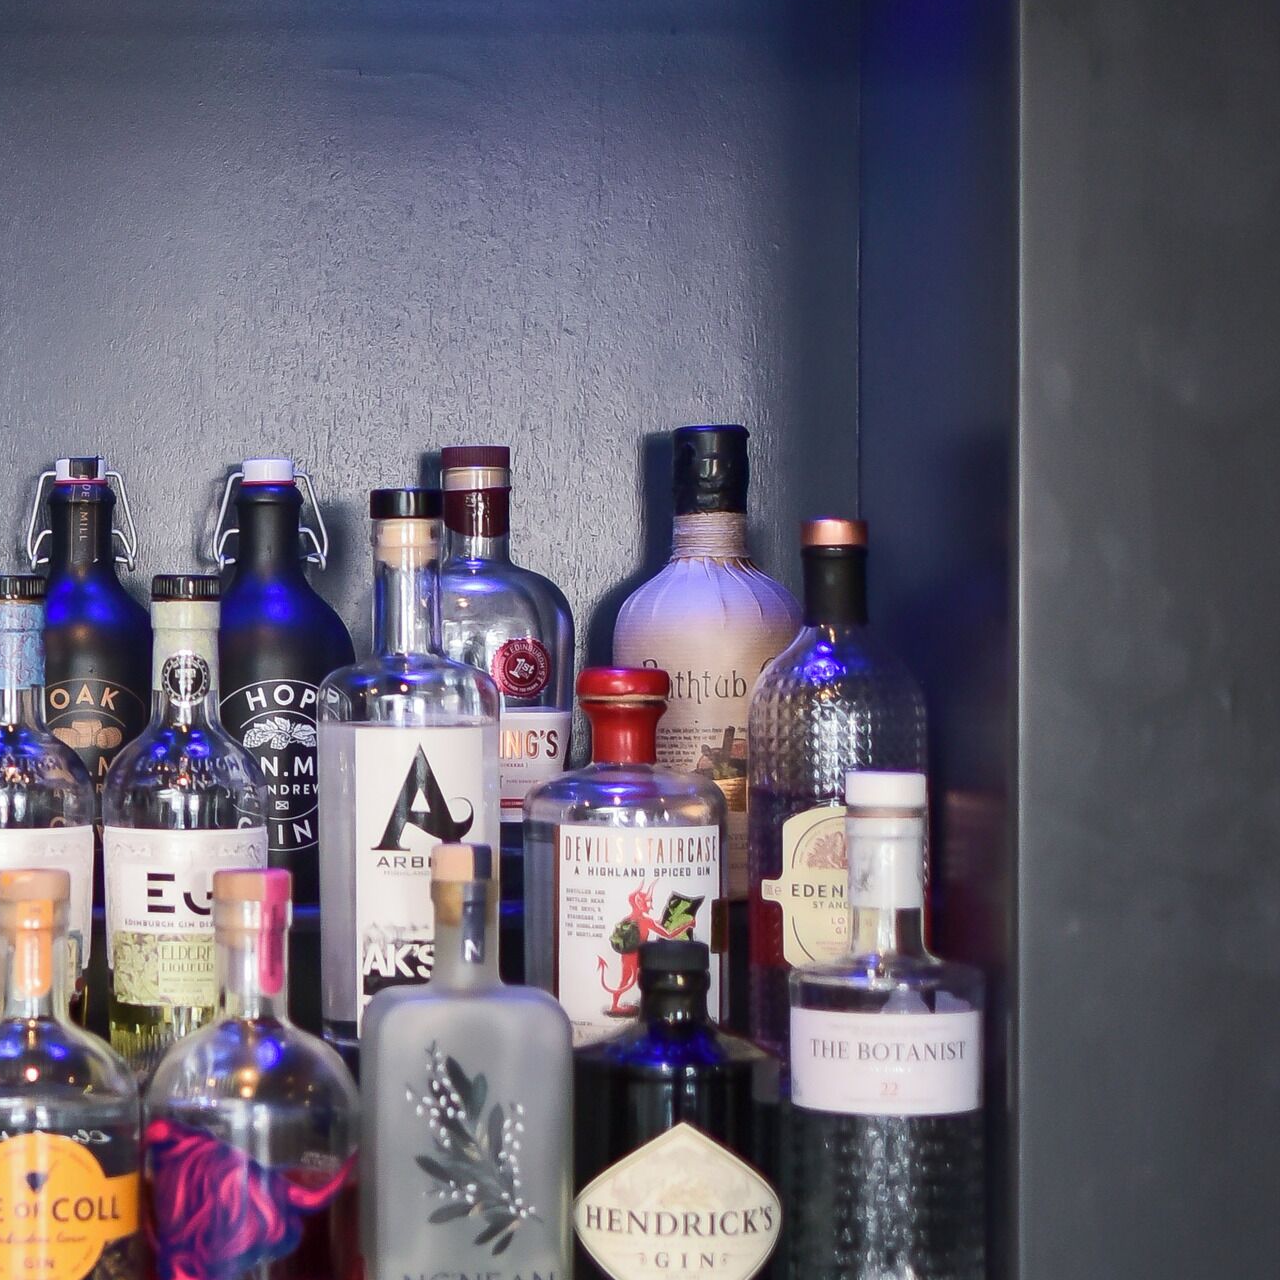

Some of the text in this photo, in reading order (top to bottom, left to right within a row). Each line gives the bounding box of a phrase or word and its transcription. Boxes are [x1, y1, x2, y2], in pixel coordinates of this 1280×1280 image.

[642, 658, 748, 705] thtub
[49, 683, 120, 711] OAK
[500, 729, 559, 760] ING'S
[376, 856, 433, 869] ARBI
[573, 866, 711, 878] A HIGHLAND SPICED GIN
[160, 944, 214, 962] ELDERF
[809, 1037, 967, 1062] THE BOTANIST
[51, 1195, 121, 1223] COLL
[585, 1203, 774, 1238] HENDRICK'S
[654, 1251, 715, 1270] GIN
